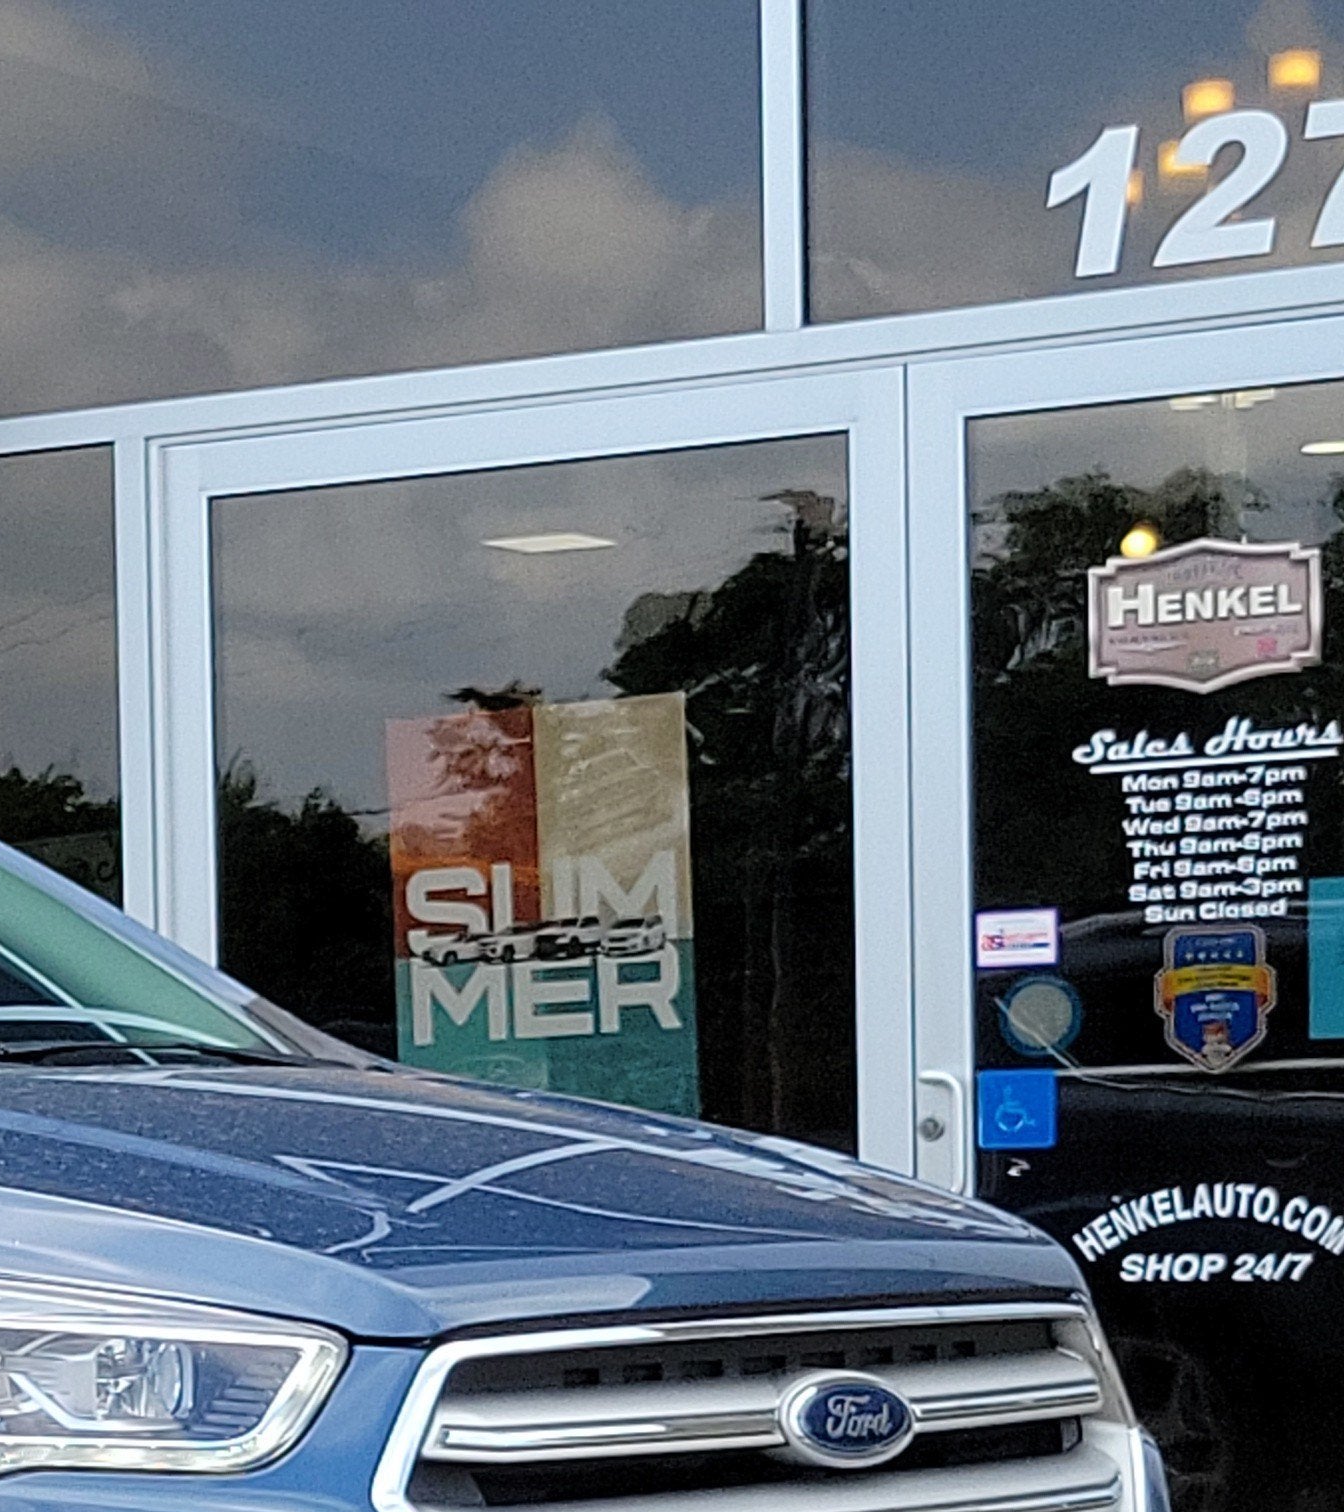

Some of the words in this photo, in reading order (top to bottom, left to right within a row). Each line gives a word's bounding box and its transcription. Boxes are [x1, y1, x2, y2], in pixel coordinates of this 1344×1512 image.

[1107, 584, 1303, 628] HENKEL
[1072, 729, 1194, 764] Sales
[1204, 716, 1344, 756] Hours
[1122, 773, 1179, 792] Mon
[1124, 796, 1171, 814] Tue
[1122, 815, 1181, 836] Wed
[1126, 839, 1176, 858] Thu
[1133, 861, 1171, 880] Fri
[1128, 883, 1176, 902] Sat
[1144, 904, 1196, 924] Sun
[1199, 897, 1288, 920] Closed
[1072, 1182, 1344, 1262] HENKELAUTO.COM
[1119, 1252, 1227, 1282] SHOP
[1230, 1252, 1313, 1282] 24/7
[826, 1394, 894, 1439] Ford
